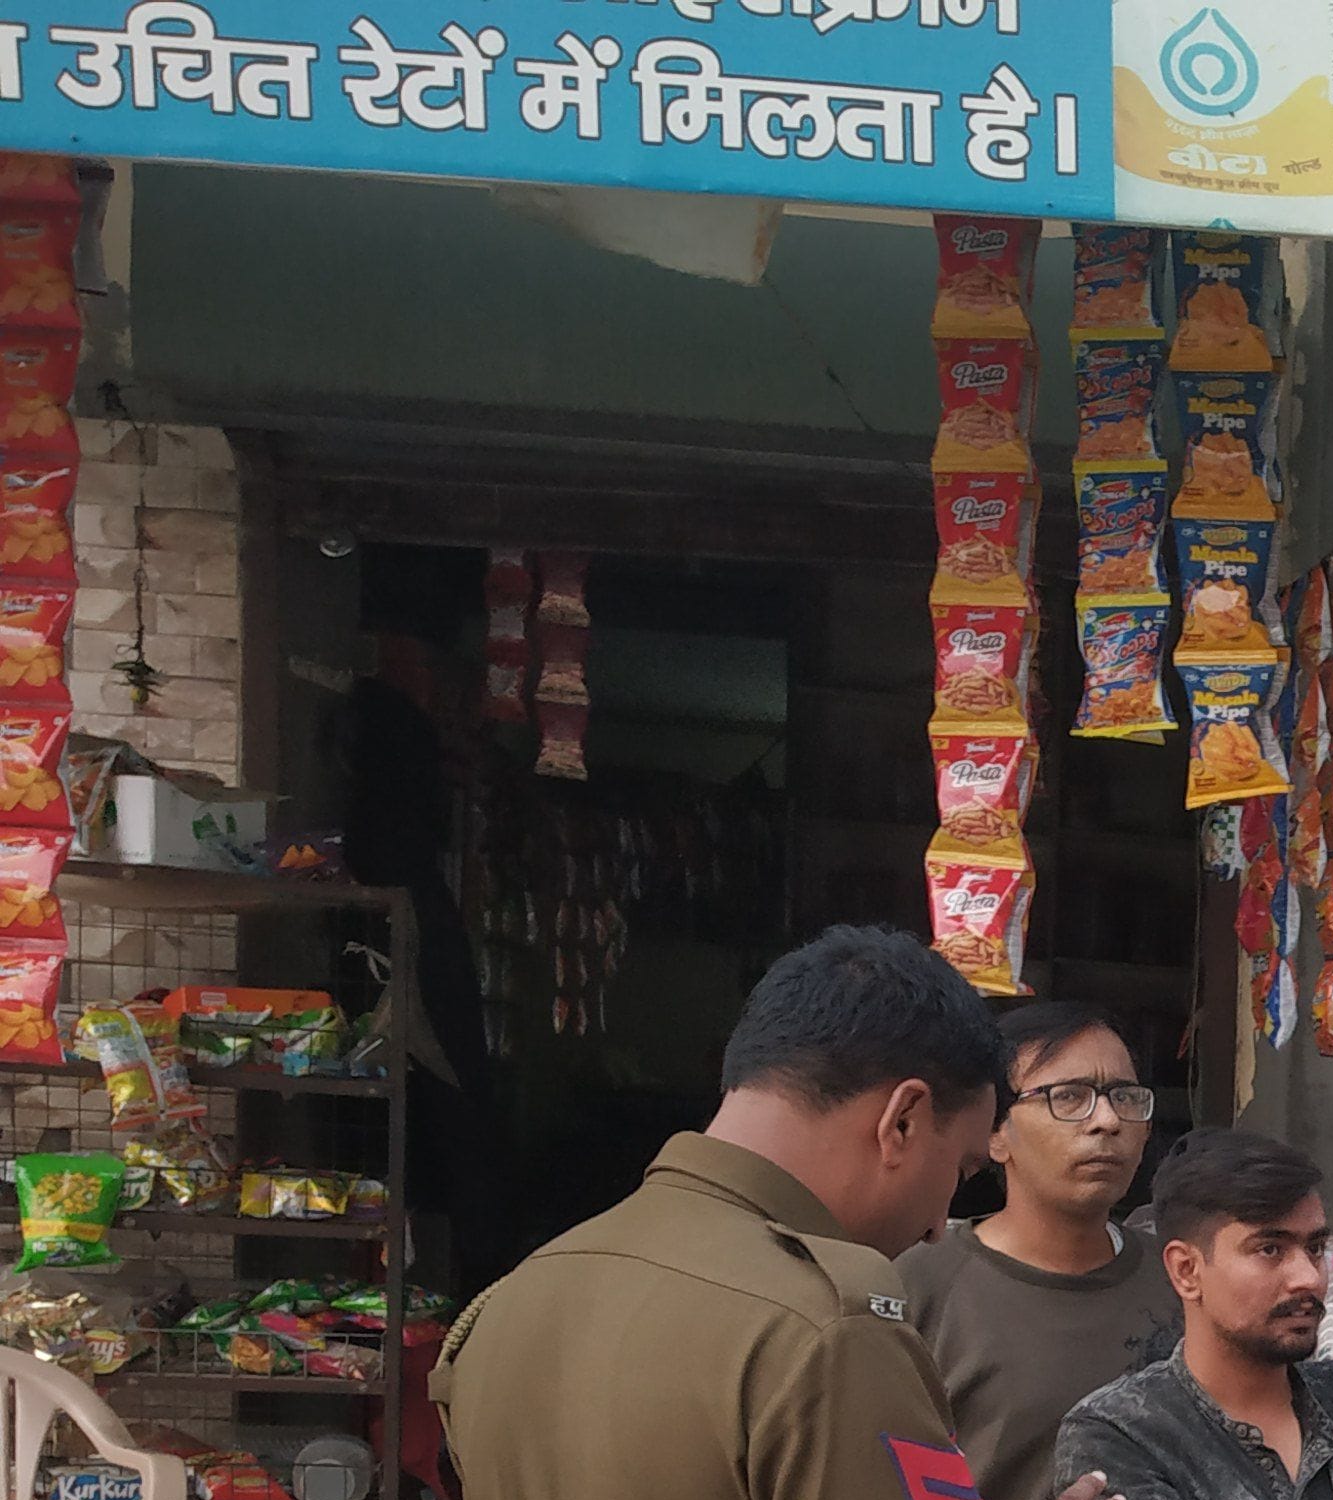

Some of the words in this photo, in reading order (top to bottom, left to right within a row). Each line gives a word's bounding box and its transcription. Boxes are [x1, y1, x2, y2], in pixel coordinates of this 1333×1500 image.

[49, 1, 319, 119] उचित
[339, 17, 507, 131] रेटों
[516, 31, 623, 140] में
[630, 36, 939, 164] मिलता
[951, 225, 1008, 254] Pasta
[1198, 264, 1241, 283] Pipe
[951, 361, 1008, 391] Pasta
[1202, 412, 1246, 431] Pipe
[951, 495, 1006, 524] Pasta
[1204, 560, 1247, 578] Pipe
[949, 628, 1006, 656] Pasta
[1207, 705, 1250, 720] Pipe
[943, 888, 1000, 915] Pasta
[88, 1341, 126, 1365] ays
